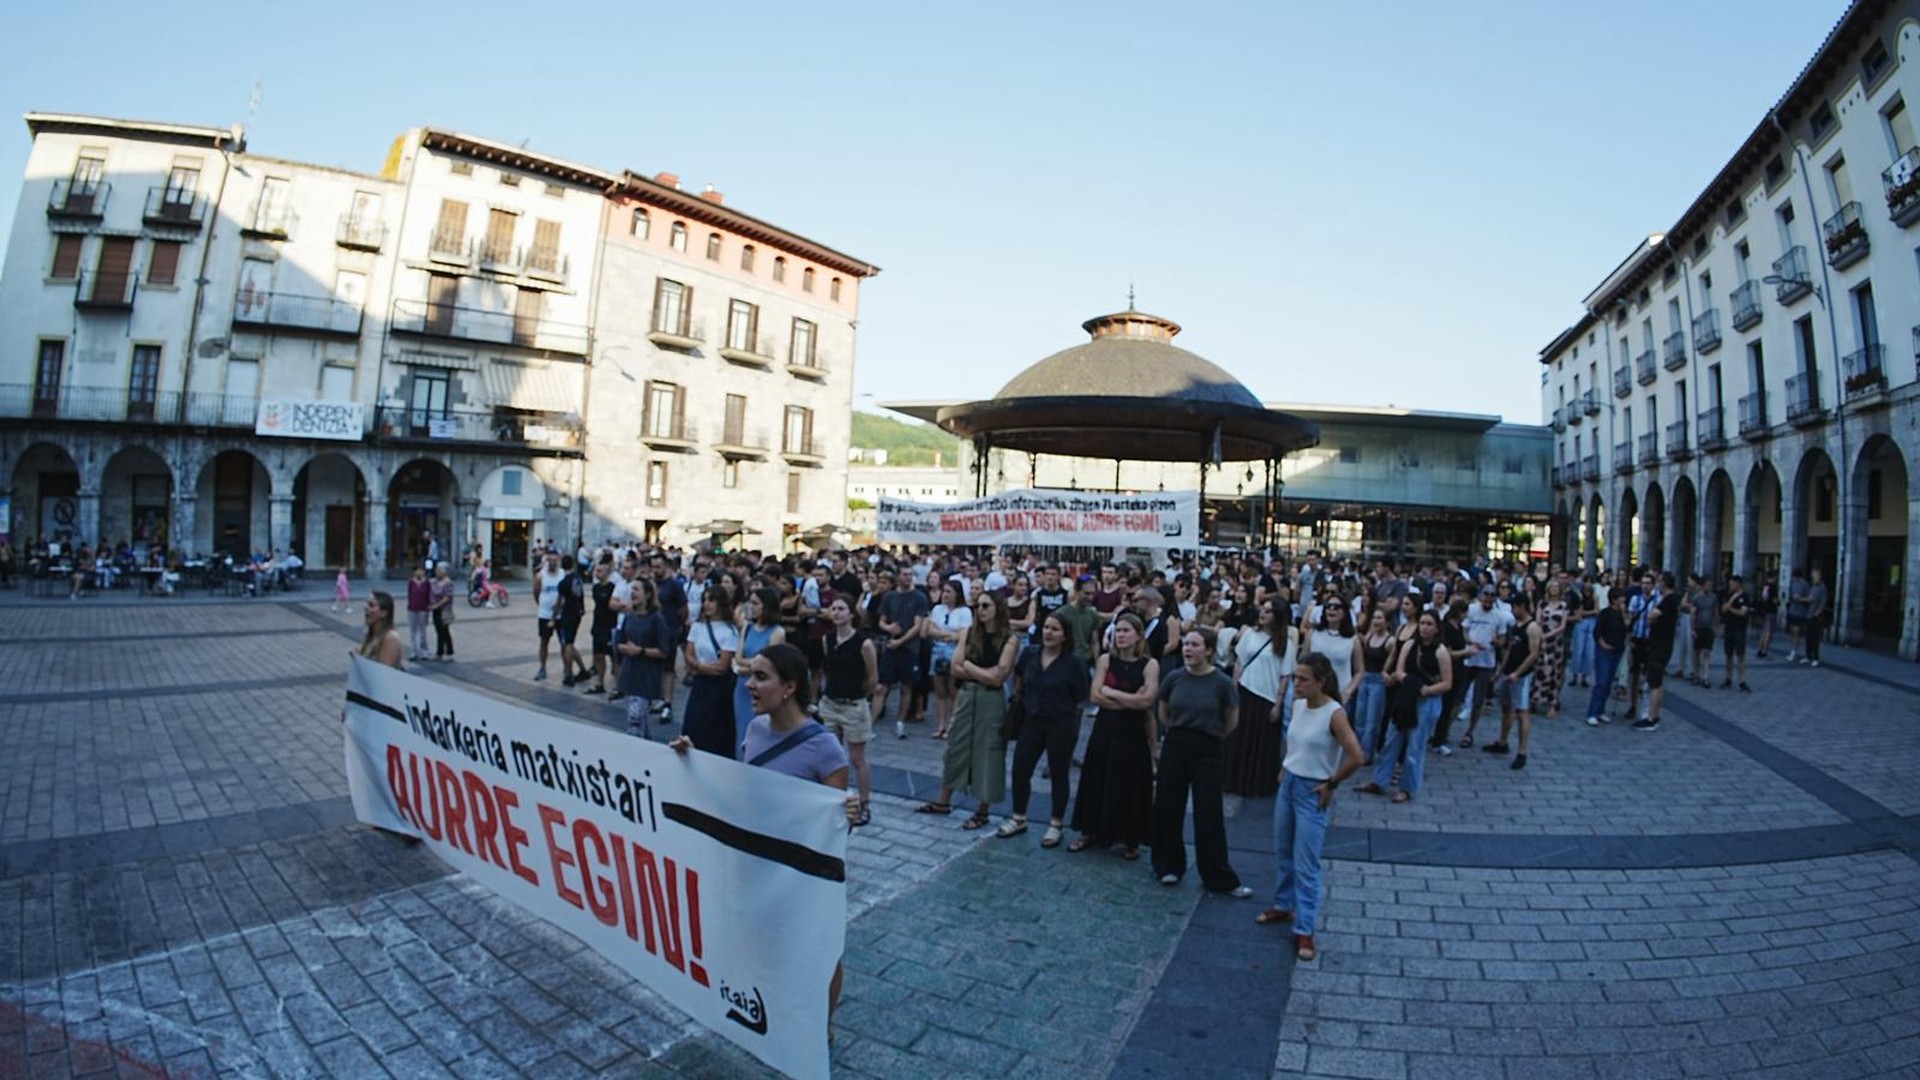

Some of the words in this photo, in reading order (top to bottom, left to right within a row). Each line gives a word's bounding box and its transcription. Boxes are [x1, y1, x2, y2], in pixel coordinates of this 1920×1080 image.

[292, 418, 348, 434] DENTZIA
[293, 404, 352, 421] INDEPEN
[404, 694, 508, 774] indarkeria
[510, 740, 656, 832] matxistari
[387, 743, 539, 887] AURRE
[538, 802, 711, 987] EGIN!
[720, 980, 760, 1021] itaia
